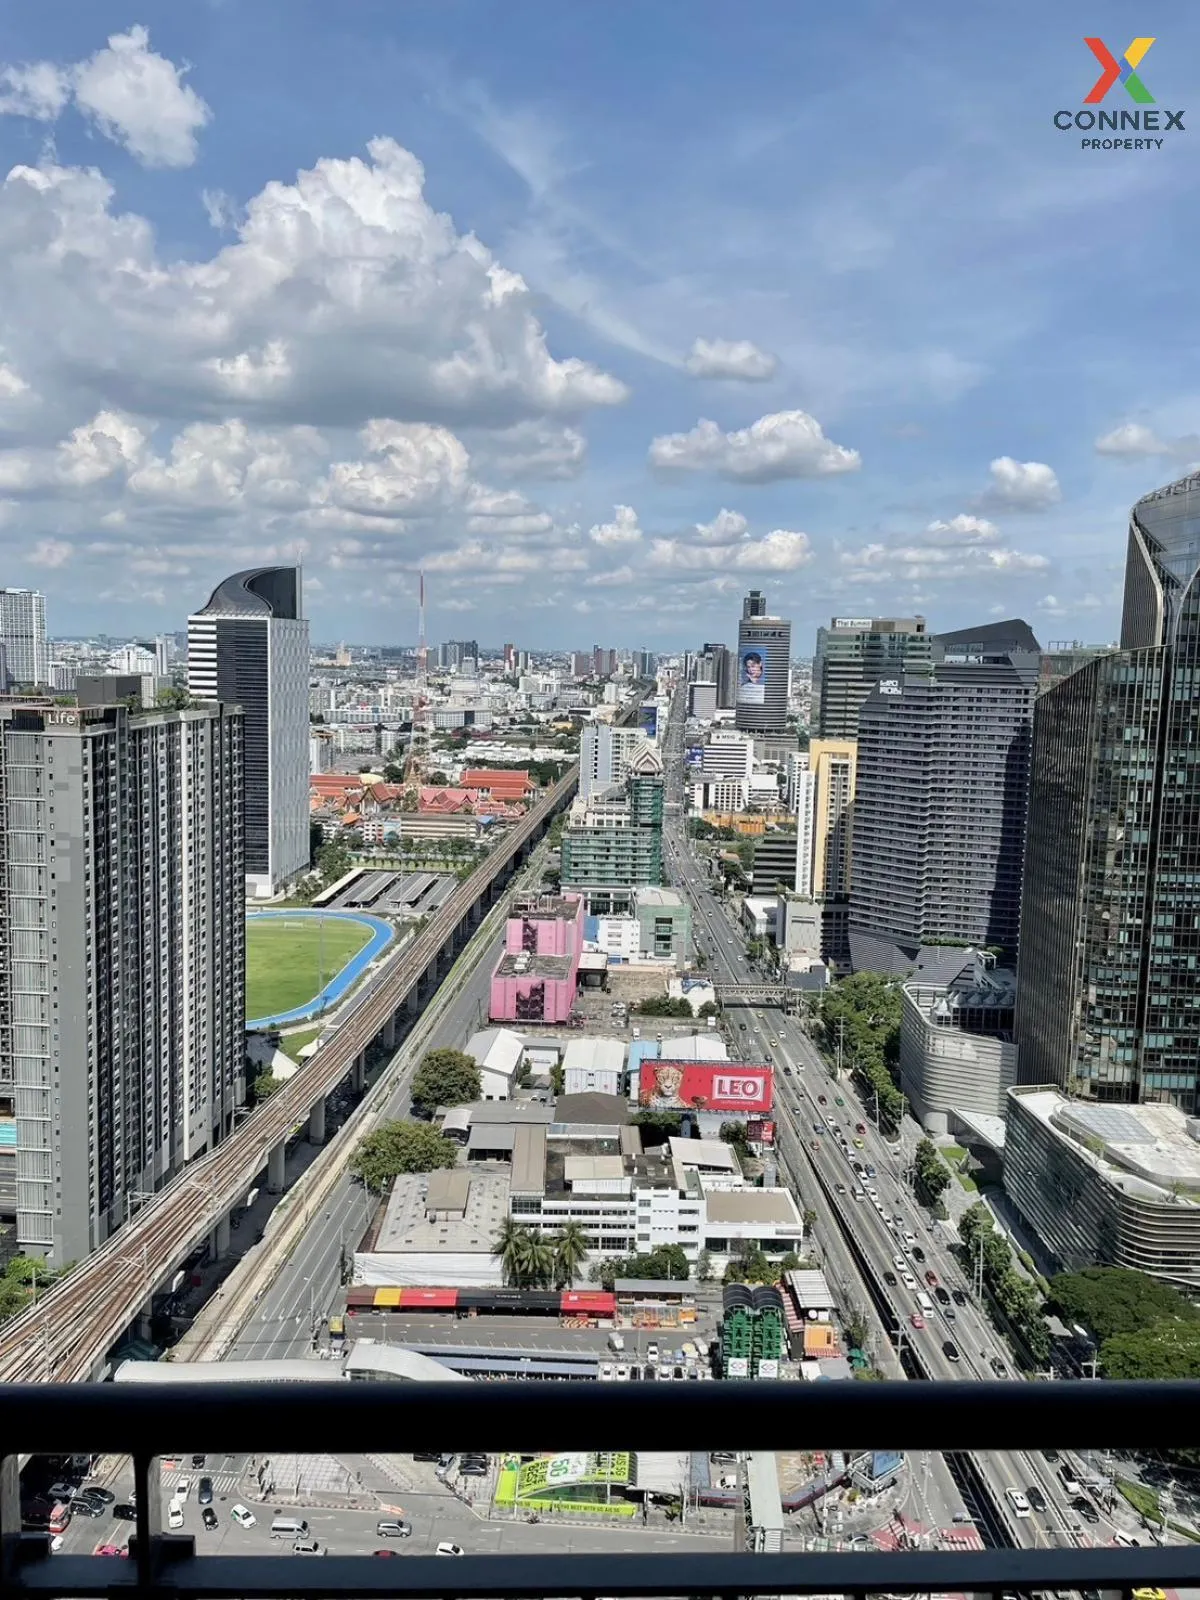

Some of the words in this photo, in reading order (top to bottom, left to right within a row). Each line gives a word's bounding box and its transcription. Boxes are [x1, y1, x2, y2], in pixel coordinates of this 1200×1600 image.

[718, 1079, 759, 1097] LEO
[615, 1453, 627, 1466] AIS
[549, 1458, 570, 1477] 5G
[615, 1467, 626, 1477] 5G
